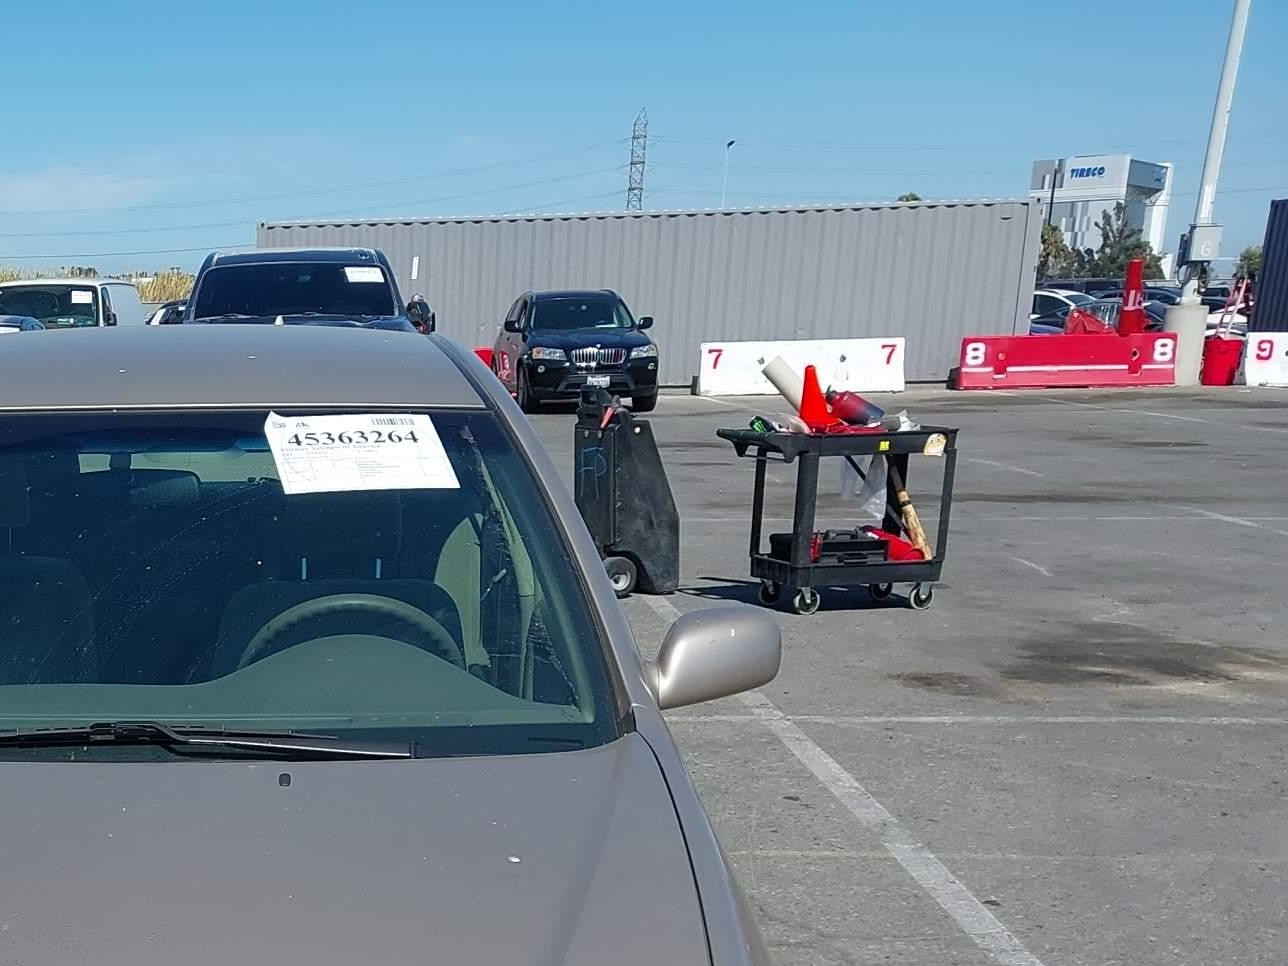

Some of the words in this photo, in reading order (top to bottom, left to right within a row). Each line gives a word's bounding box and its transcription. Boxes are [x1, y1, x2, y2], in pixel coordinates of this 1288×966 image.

[1069, 166, 1106, 180] TIRECO
[707, 348, 724, 370] 7
[881, 344, 897, 366] 7
[964, 341, 987, 366] 8
[1152, 337, 1175, 362] 8
[1255, 339, 1274, 361] 9
[287, 430, 419, 447] 45363264
